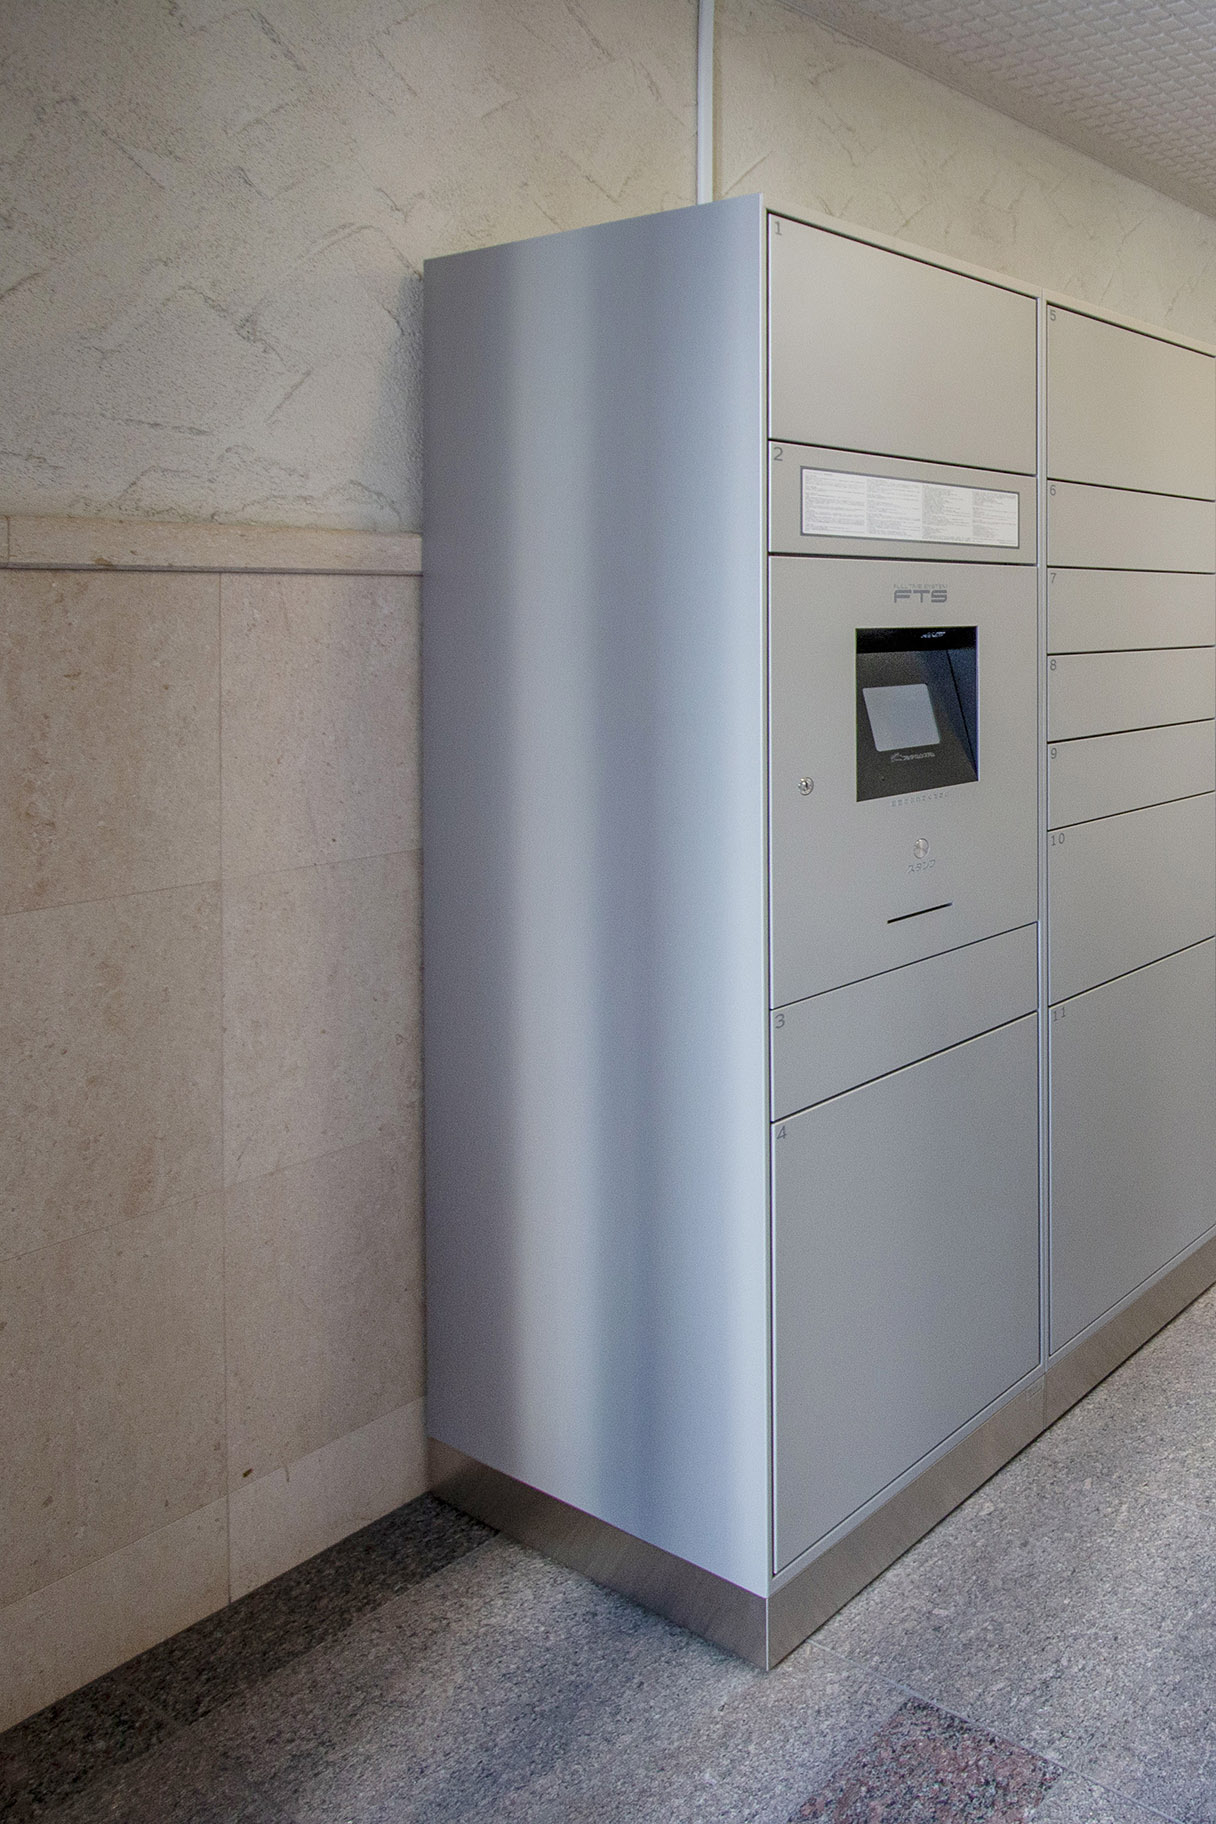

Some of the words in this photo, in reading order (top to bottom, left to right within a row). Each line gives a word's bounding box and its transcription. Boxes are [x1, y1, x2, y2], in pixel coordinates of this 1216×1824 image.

[774, 221, 783, 236] 1
[1049, 309, 1057, 321] 5
[773, 446, 783, 461] 2
[1049, 484, 1057, 496] 6
[1050, 572, 1057, 584] 7
[893, 589, 947, 603] FTS
[1049, 659, 1057, 671] 8
[1050, 747, 1058, 759] 9
[1051, 832, 1065, 847] 10
[775, 1013, 785, 1029] 3
[1053, 1007, 1066, 1022] 11
[776, 1125, 787, 1140] 4
